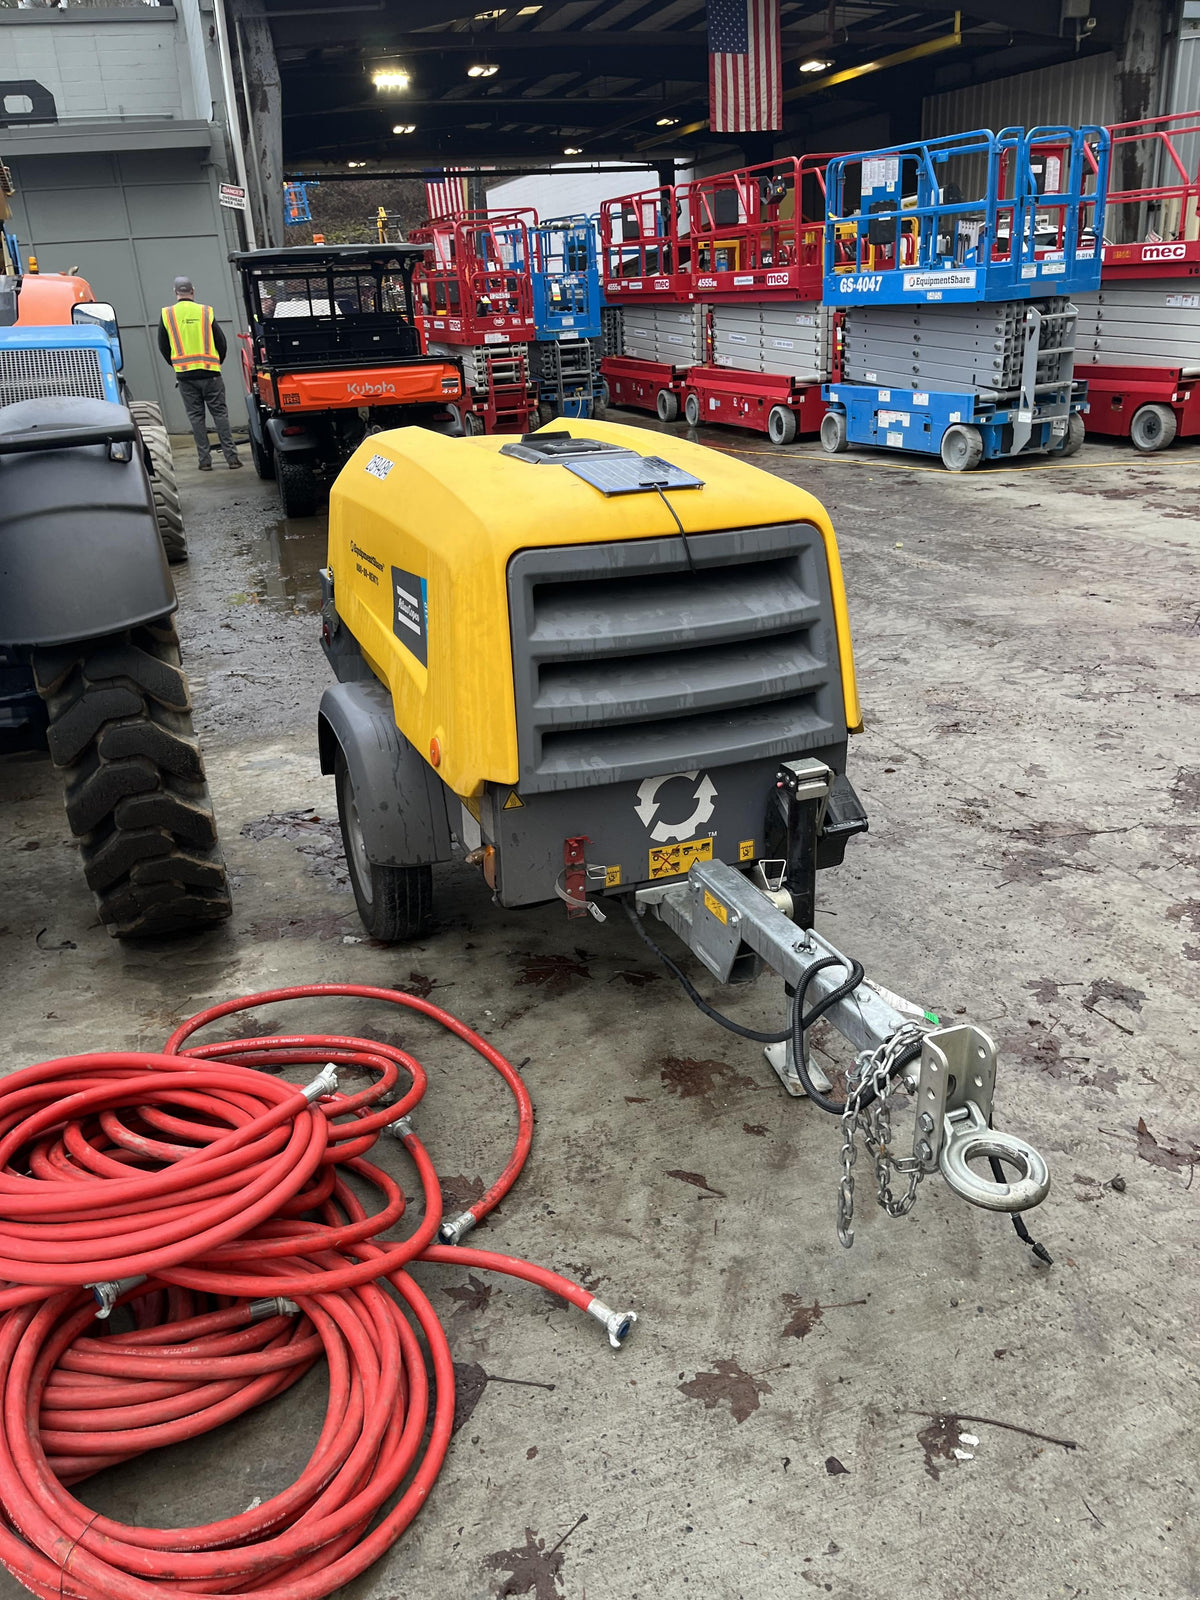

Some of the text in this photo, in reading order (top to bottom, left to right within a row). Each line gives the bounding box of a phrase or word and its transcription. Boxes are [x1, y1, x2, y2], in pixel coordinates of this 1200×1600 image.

[1143, 246, 1185, 259] mec
[655, 280, 669, 289] mec
[767, 274, 788, 284] mec
[916, 275, 970, 287] EquipmentShare
[347, 381, 396, 395] Kubota
